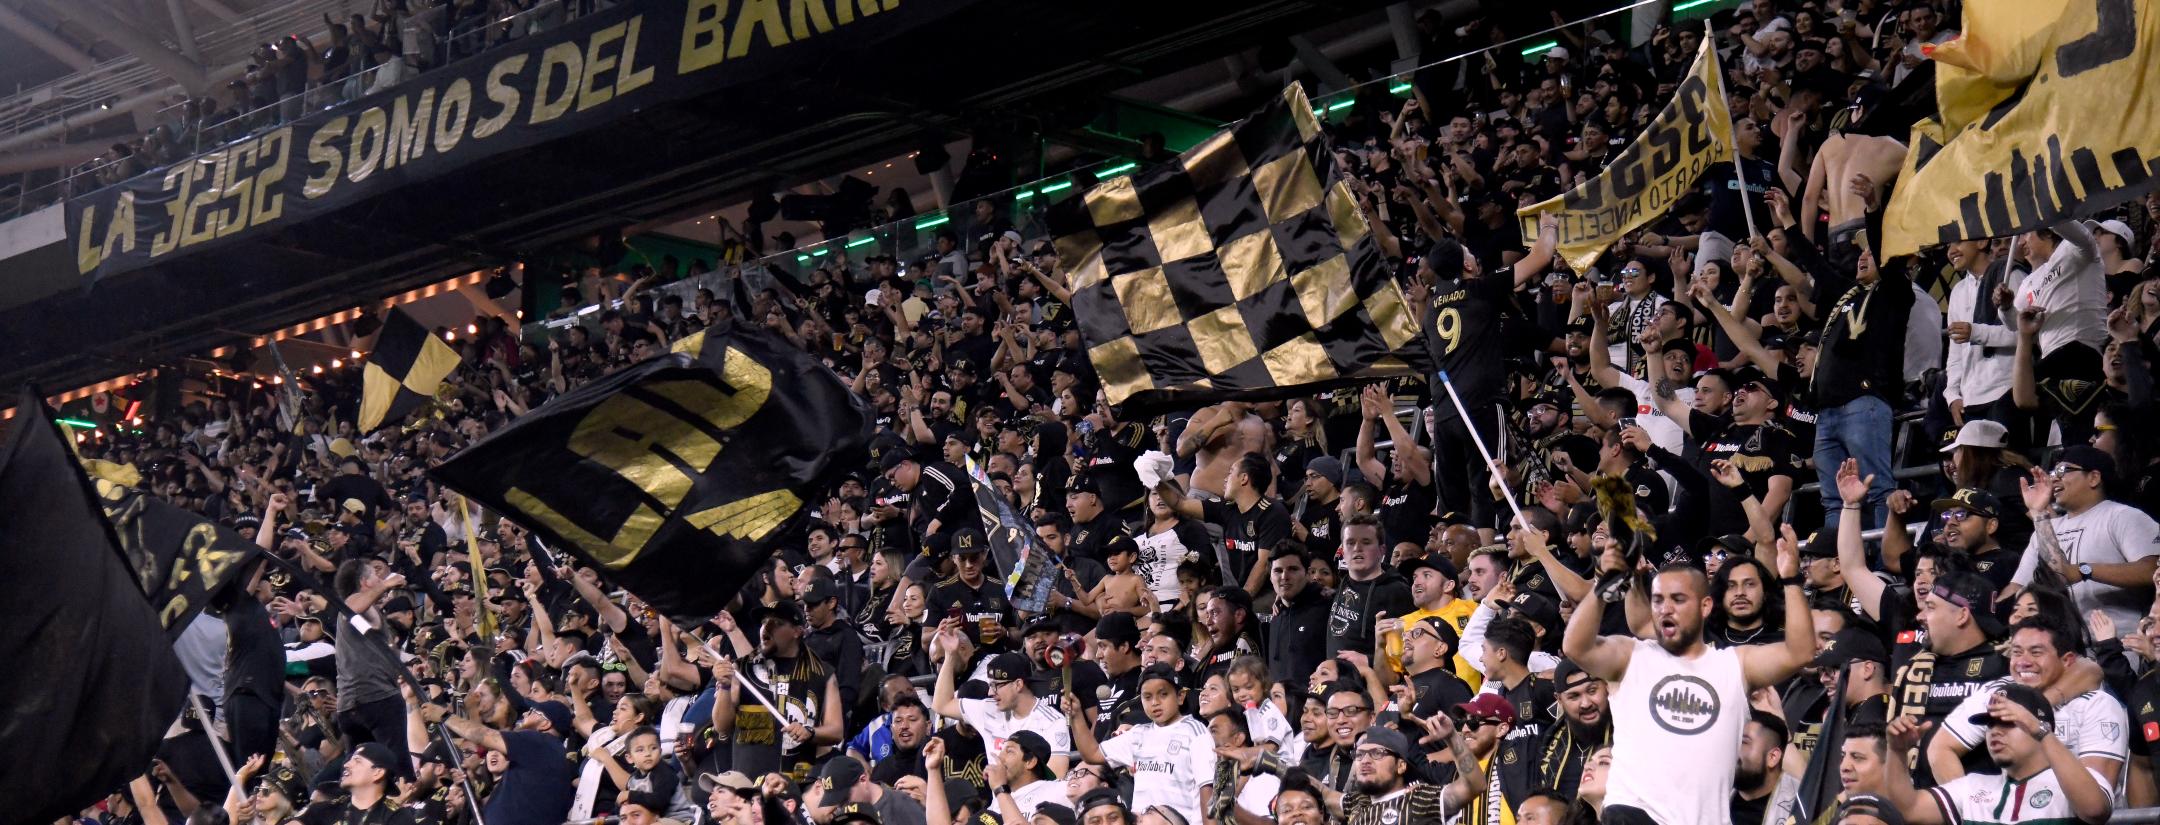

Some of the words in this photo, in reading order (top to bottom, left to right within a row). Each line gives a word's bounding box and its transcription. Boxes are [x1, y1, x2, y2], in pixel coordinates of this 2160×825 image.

[77, 190, 136, 276] LA
[150, 126, 292, 258] 3252
[303, 52, 528, 199] SOMOS
[529, 14, 654, 125] DEL
[1432, 289, 1466, 309] VENADO
[1436, 307, 1462, 356] 9
